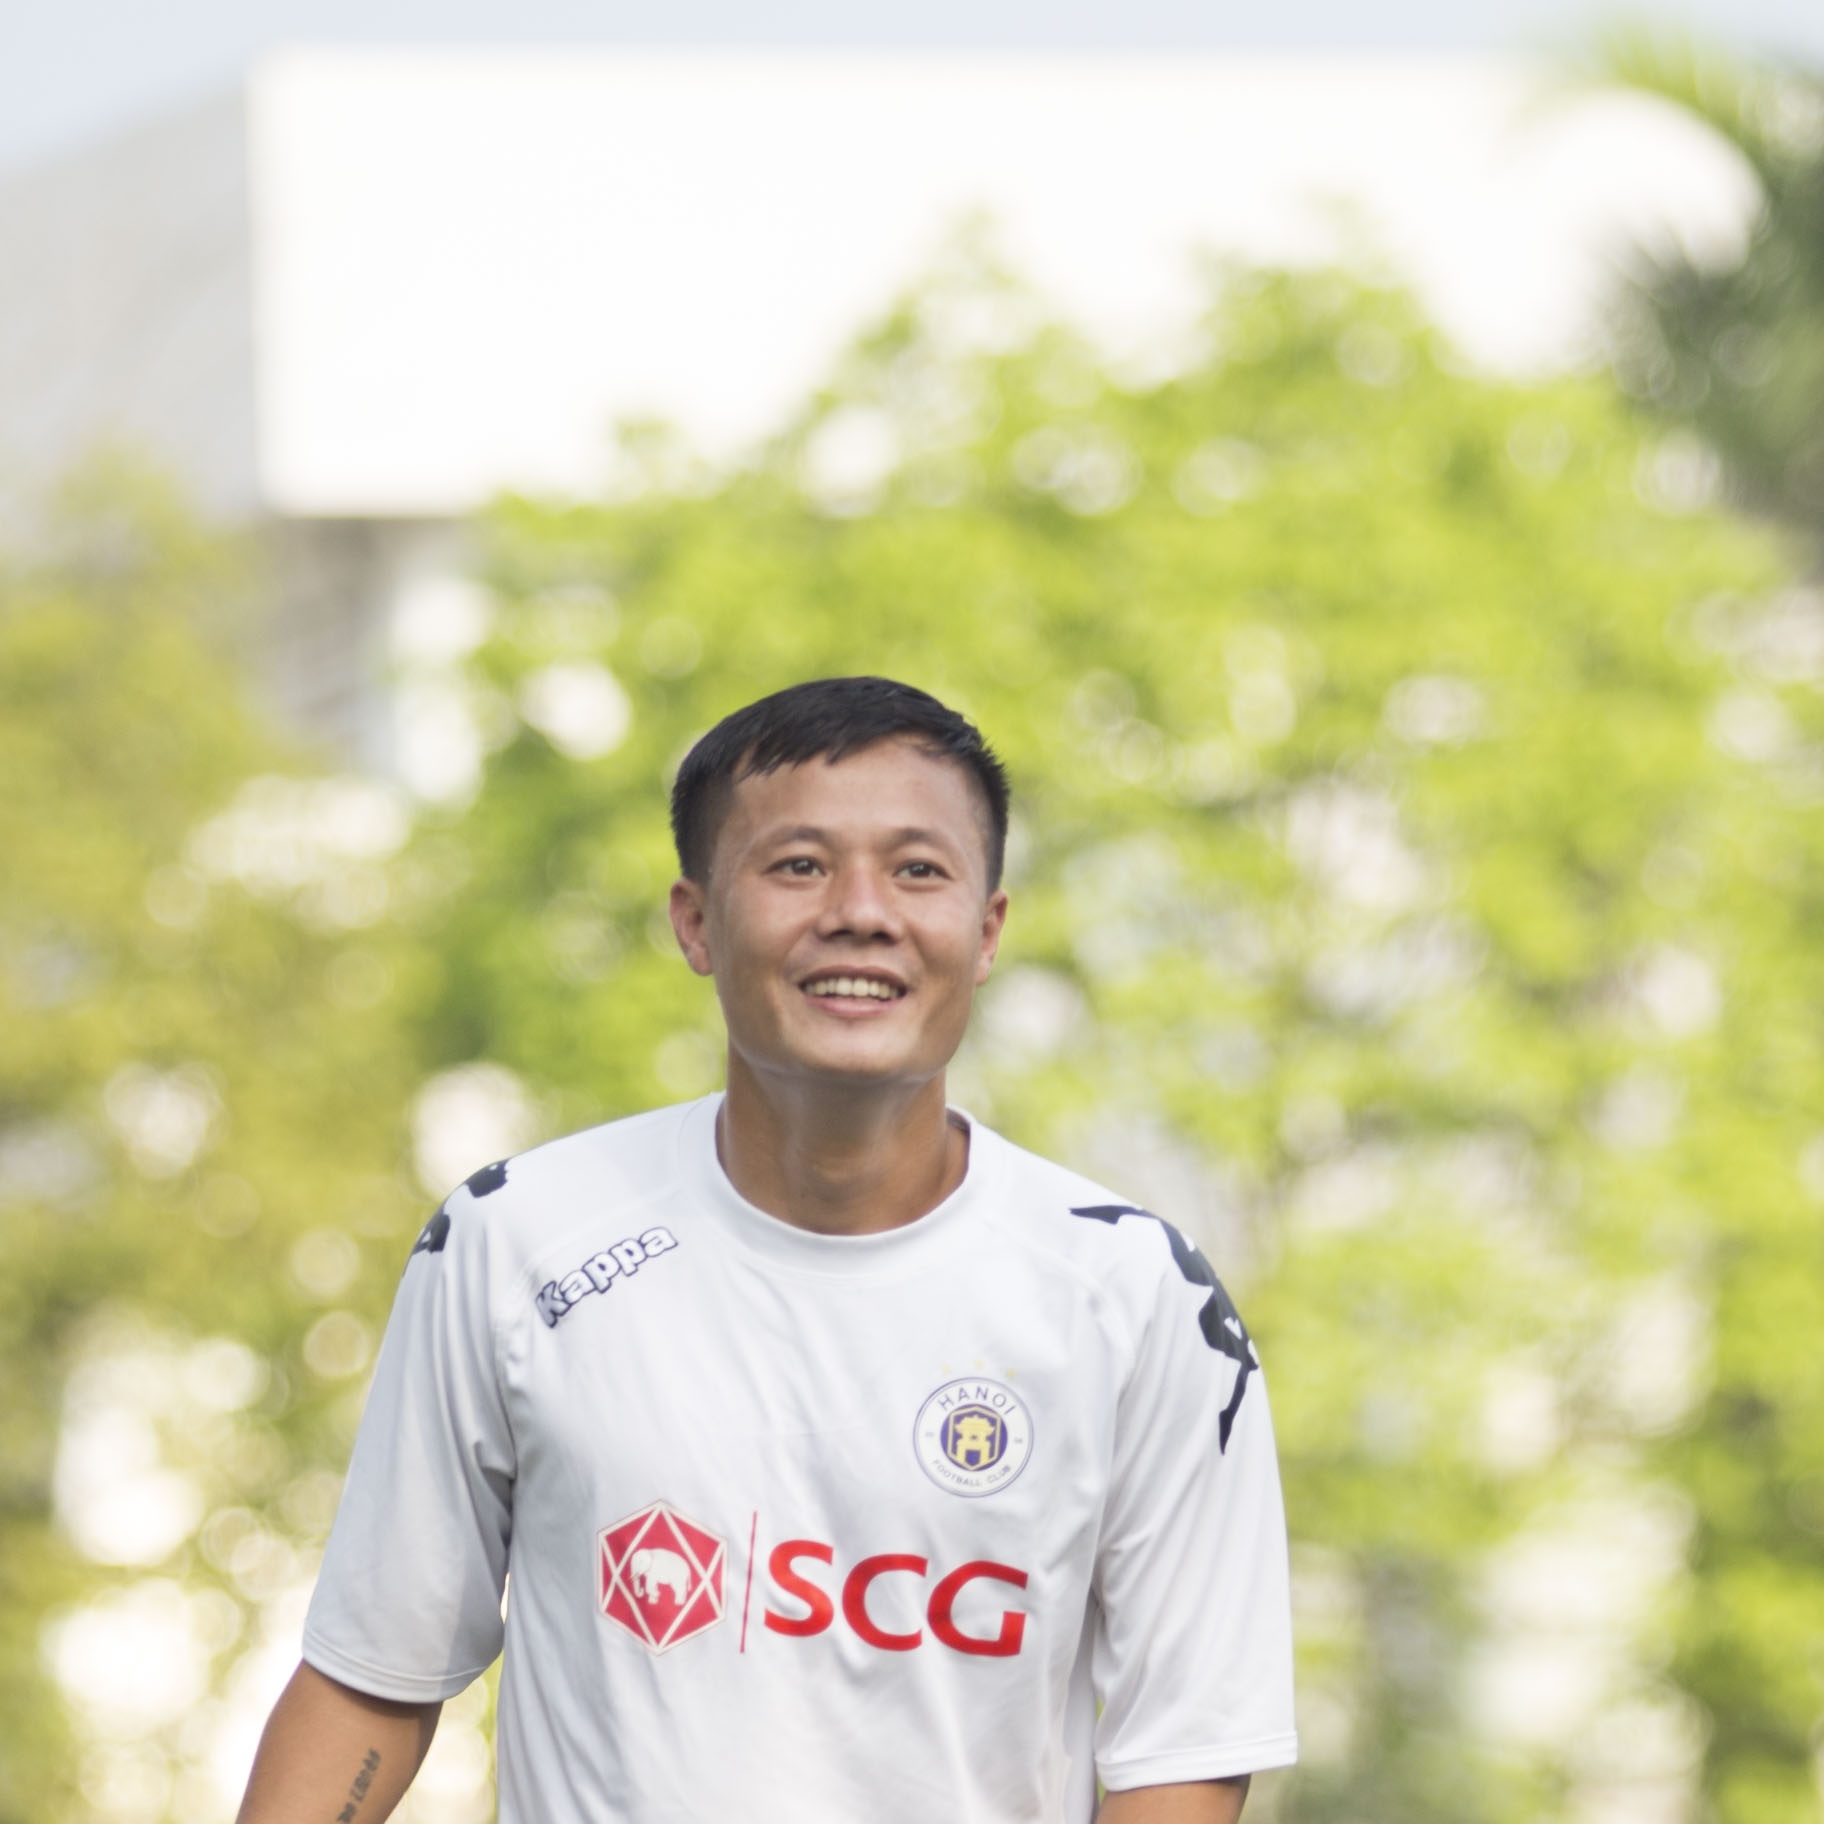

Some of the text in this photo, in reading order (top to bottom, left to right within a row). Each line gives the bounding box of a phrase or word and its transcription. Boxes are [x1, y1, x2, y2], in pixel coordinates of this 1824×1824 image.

[535, 1226, 679, 1329] Kappa
[937, 1386, 1016, 1414] HANOI
[764, 1539, 1029, 1657] SCG
